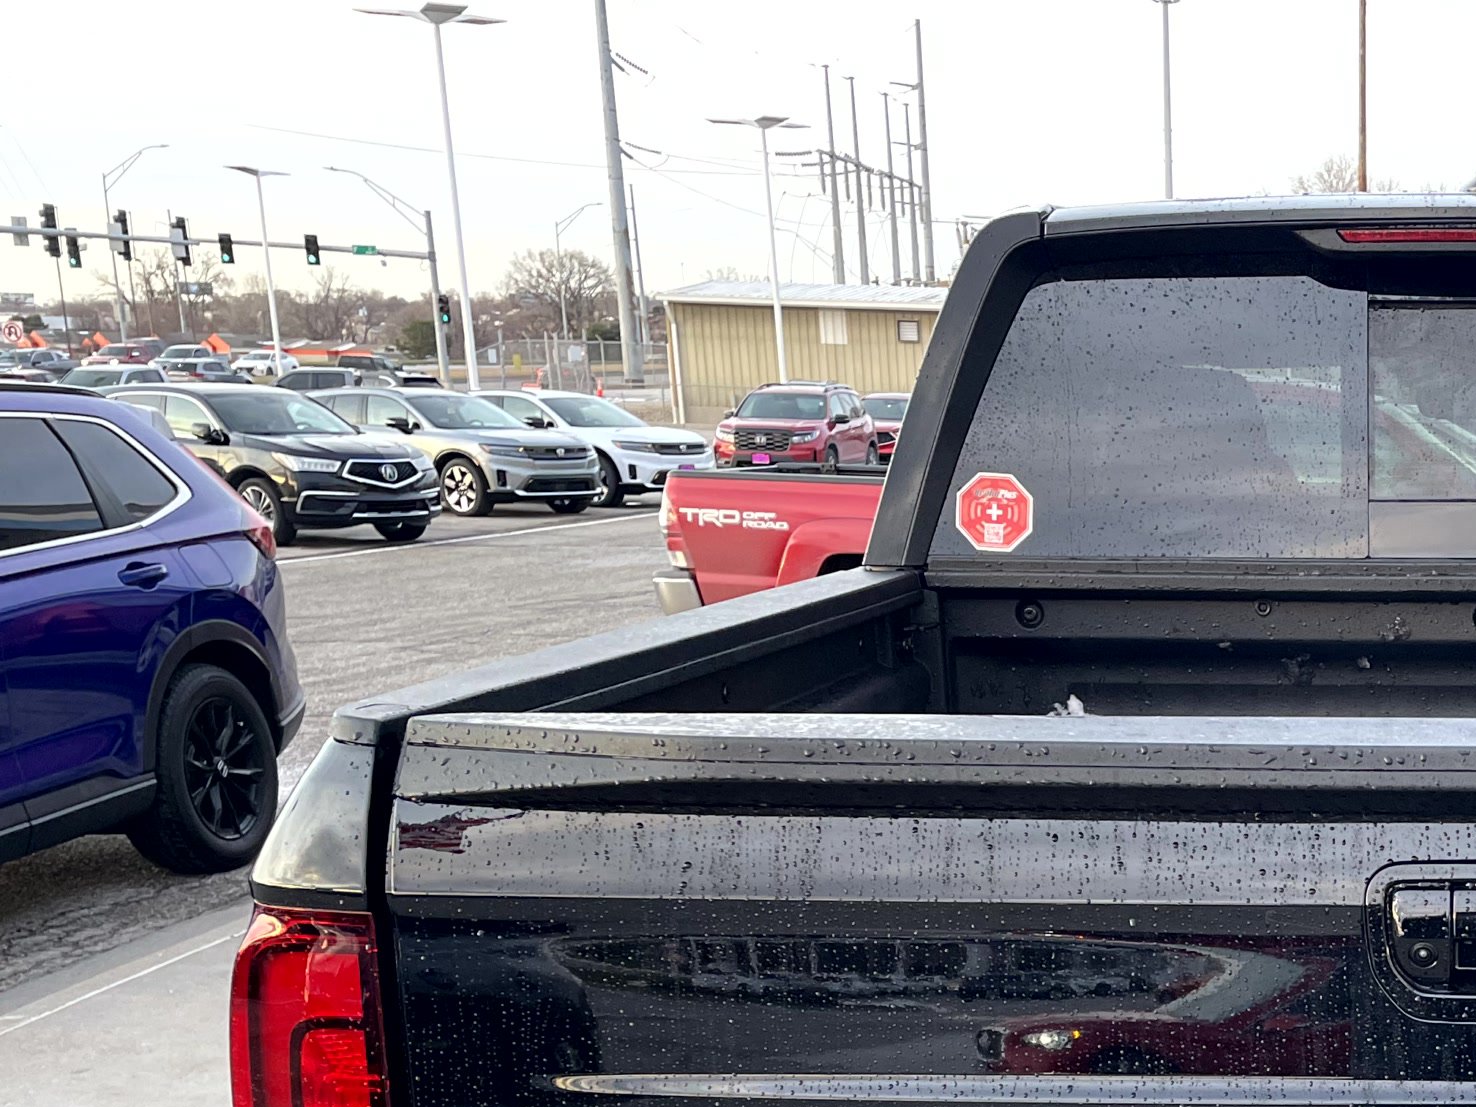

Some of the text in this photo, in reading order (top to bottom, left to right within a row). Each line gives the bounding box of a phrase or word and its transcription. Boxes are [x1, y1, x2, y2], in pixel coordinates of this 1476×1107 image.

[679, 507, 777, 527] TRD OFF
[743, 520, 790, 531] ROAD
